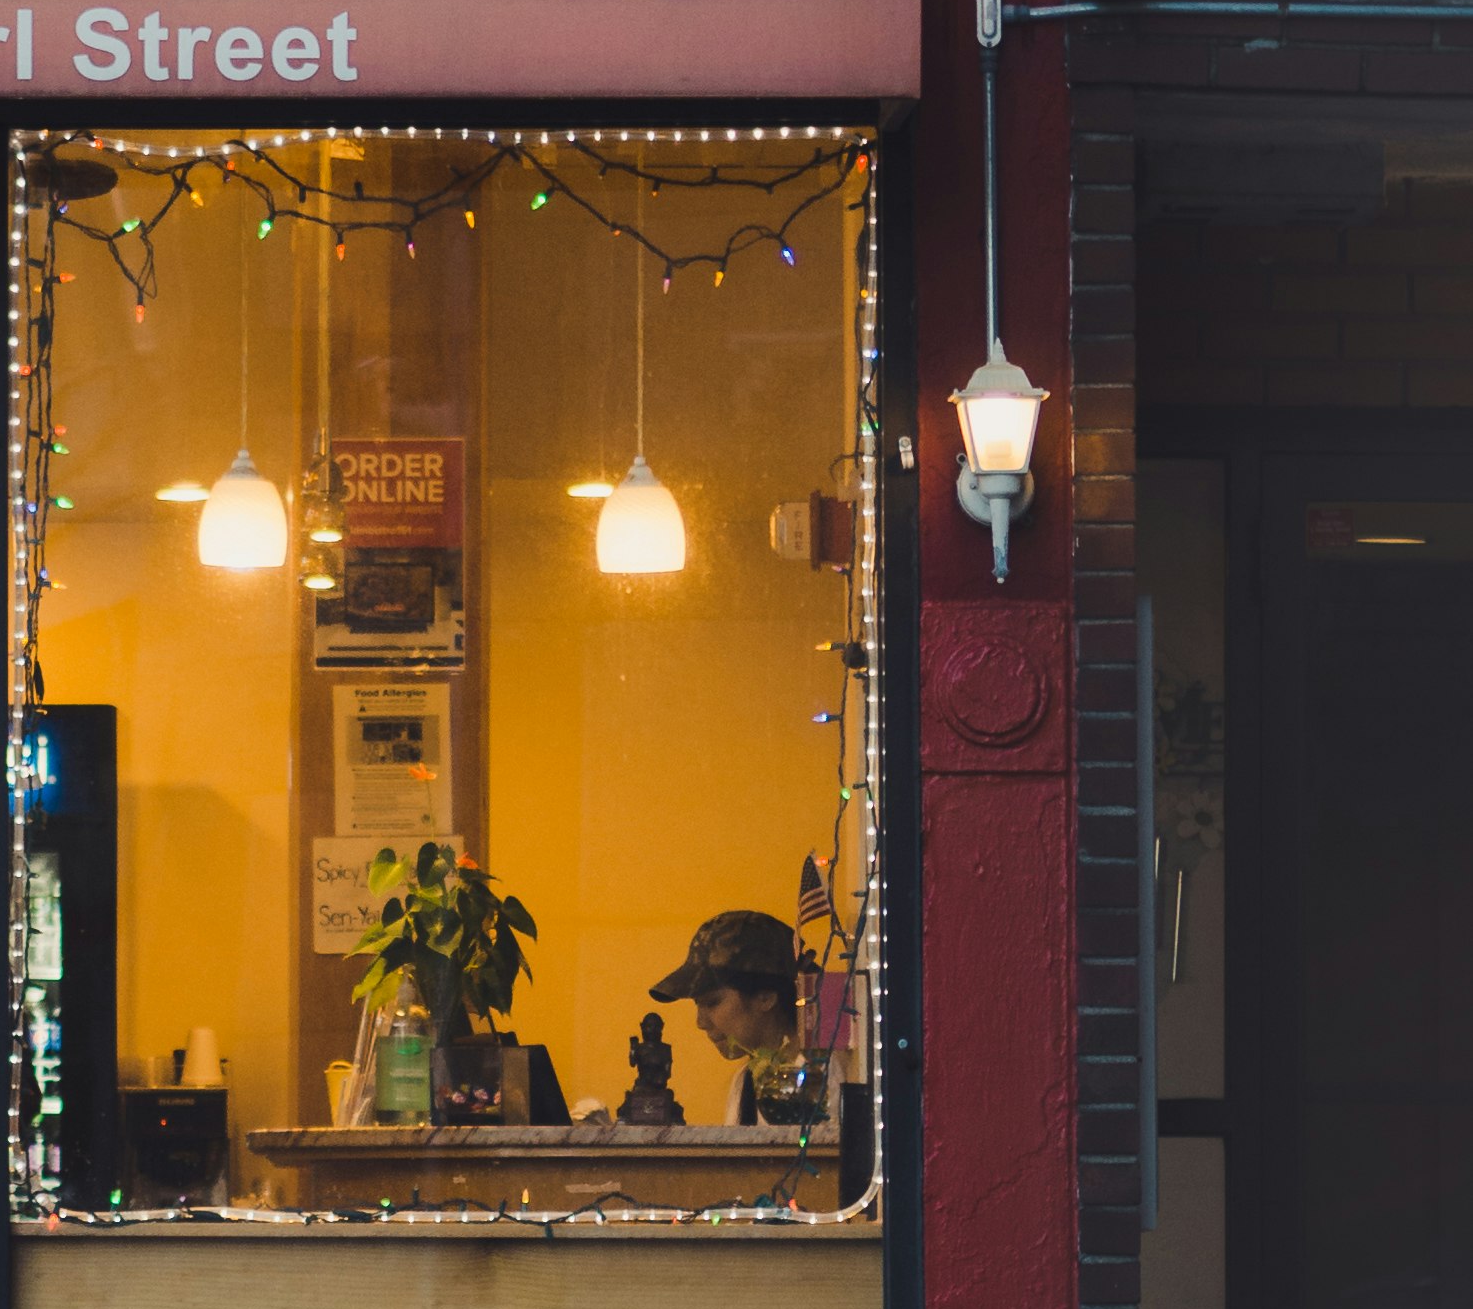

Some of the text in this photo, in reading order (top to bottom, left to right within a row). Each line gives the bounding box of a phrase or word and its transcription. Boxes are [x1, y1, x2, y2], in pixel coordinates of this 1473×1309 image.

[72, 7, 358, 81] Street
[334, 452, 444, 478] ORDER
[354, 689, 379, 697] Food
[316, 857, 360, 887] Spicy
